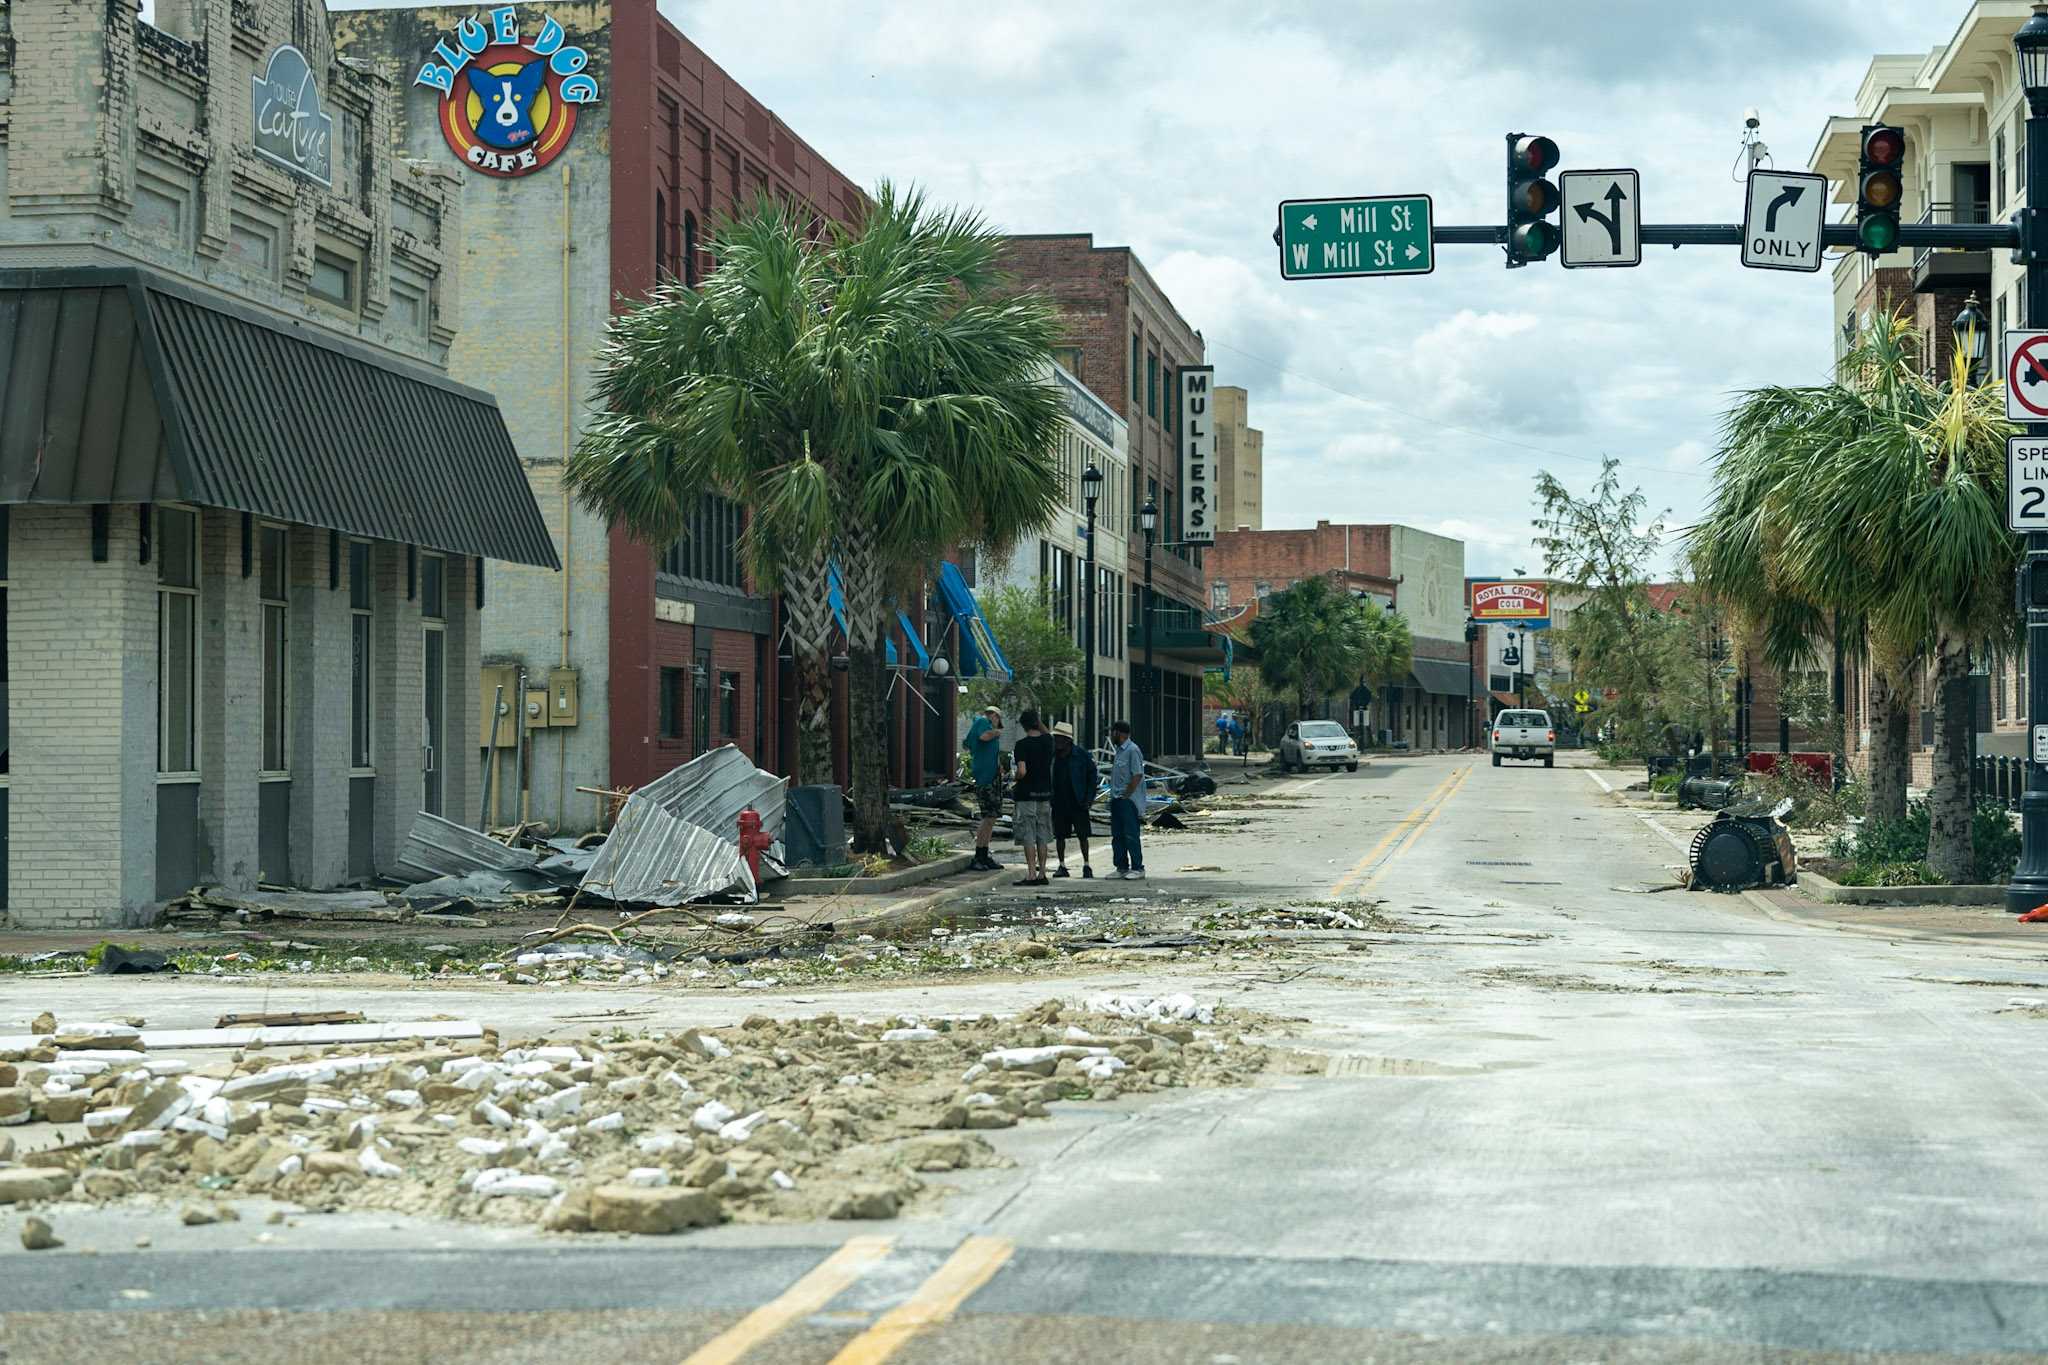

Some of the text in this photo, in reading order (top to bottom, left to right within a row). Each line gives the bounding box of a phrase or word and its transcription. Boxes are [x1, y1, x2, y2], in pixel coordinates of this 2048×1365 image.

[412, 6, 601, 104] BLUE DOG
[1340, 204, 1412, 234] Mill St
[1292, 239, 1395, 270] W Mill St
[1753, 237, 1812, 258] ONLY
[1188, 375, 1208, 527] MULLER'S
[2018, 485, 2047, 519] 2
[1477, 586, 1543, 602] ROYAL CROWN
[1499, 600, 1522, 608] COLA
